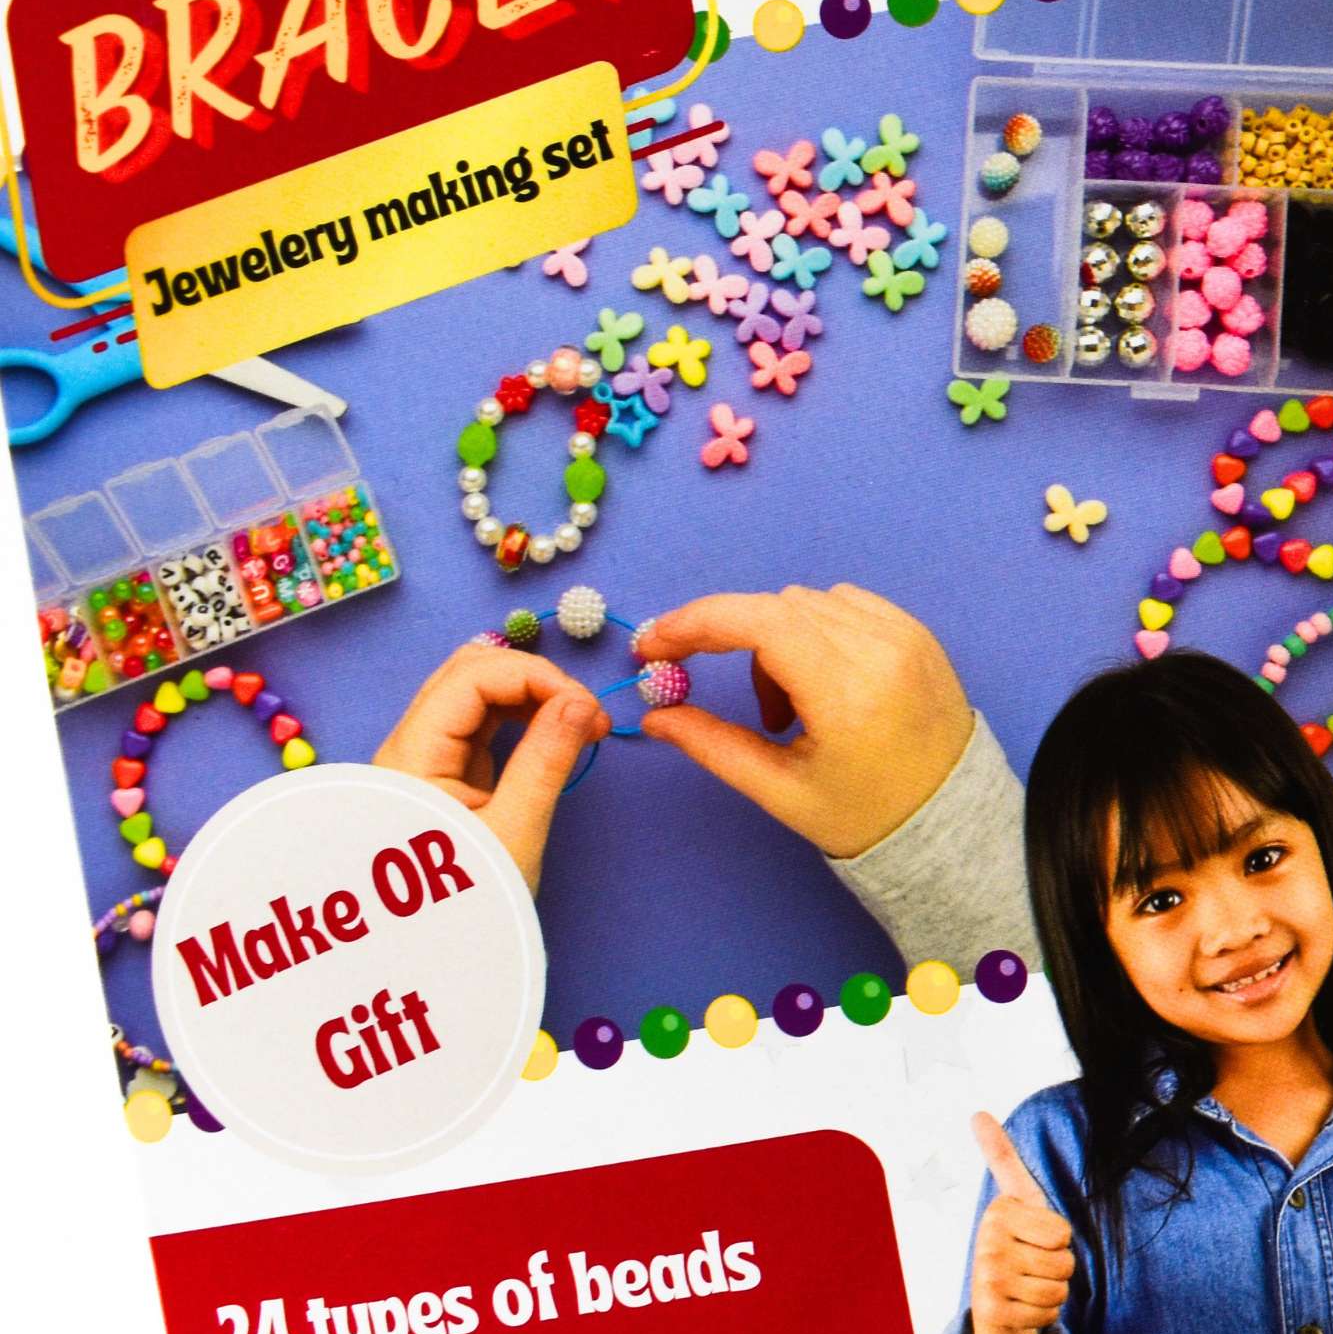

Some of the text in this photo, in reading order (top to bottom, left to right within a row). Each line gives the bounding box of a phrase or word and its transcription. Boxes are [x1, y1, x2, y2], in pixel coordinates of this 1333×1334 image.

[143, 118, 614, 316] Jewelery making set
[176, 829, 475, 1007] Make OR
[315, 989, 441, 1089] Gift
[492, 1250, 558, 1327] of
[568, 1230, 761, 1315] beads
